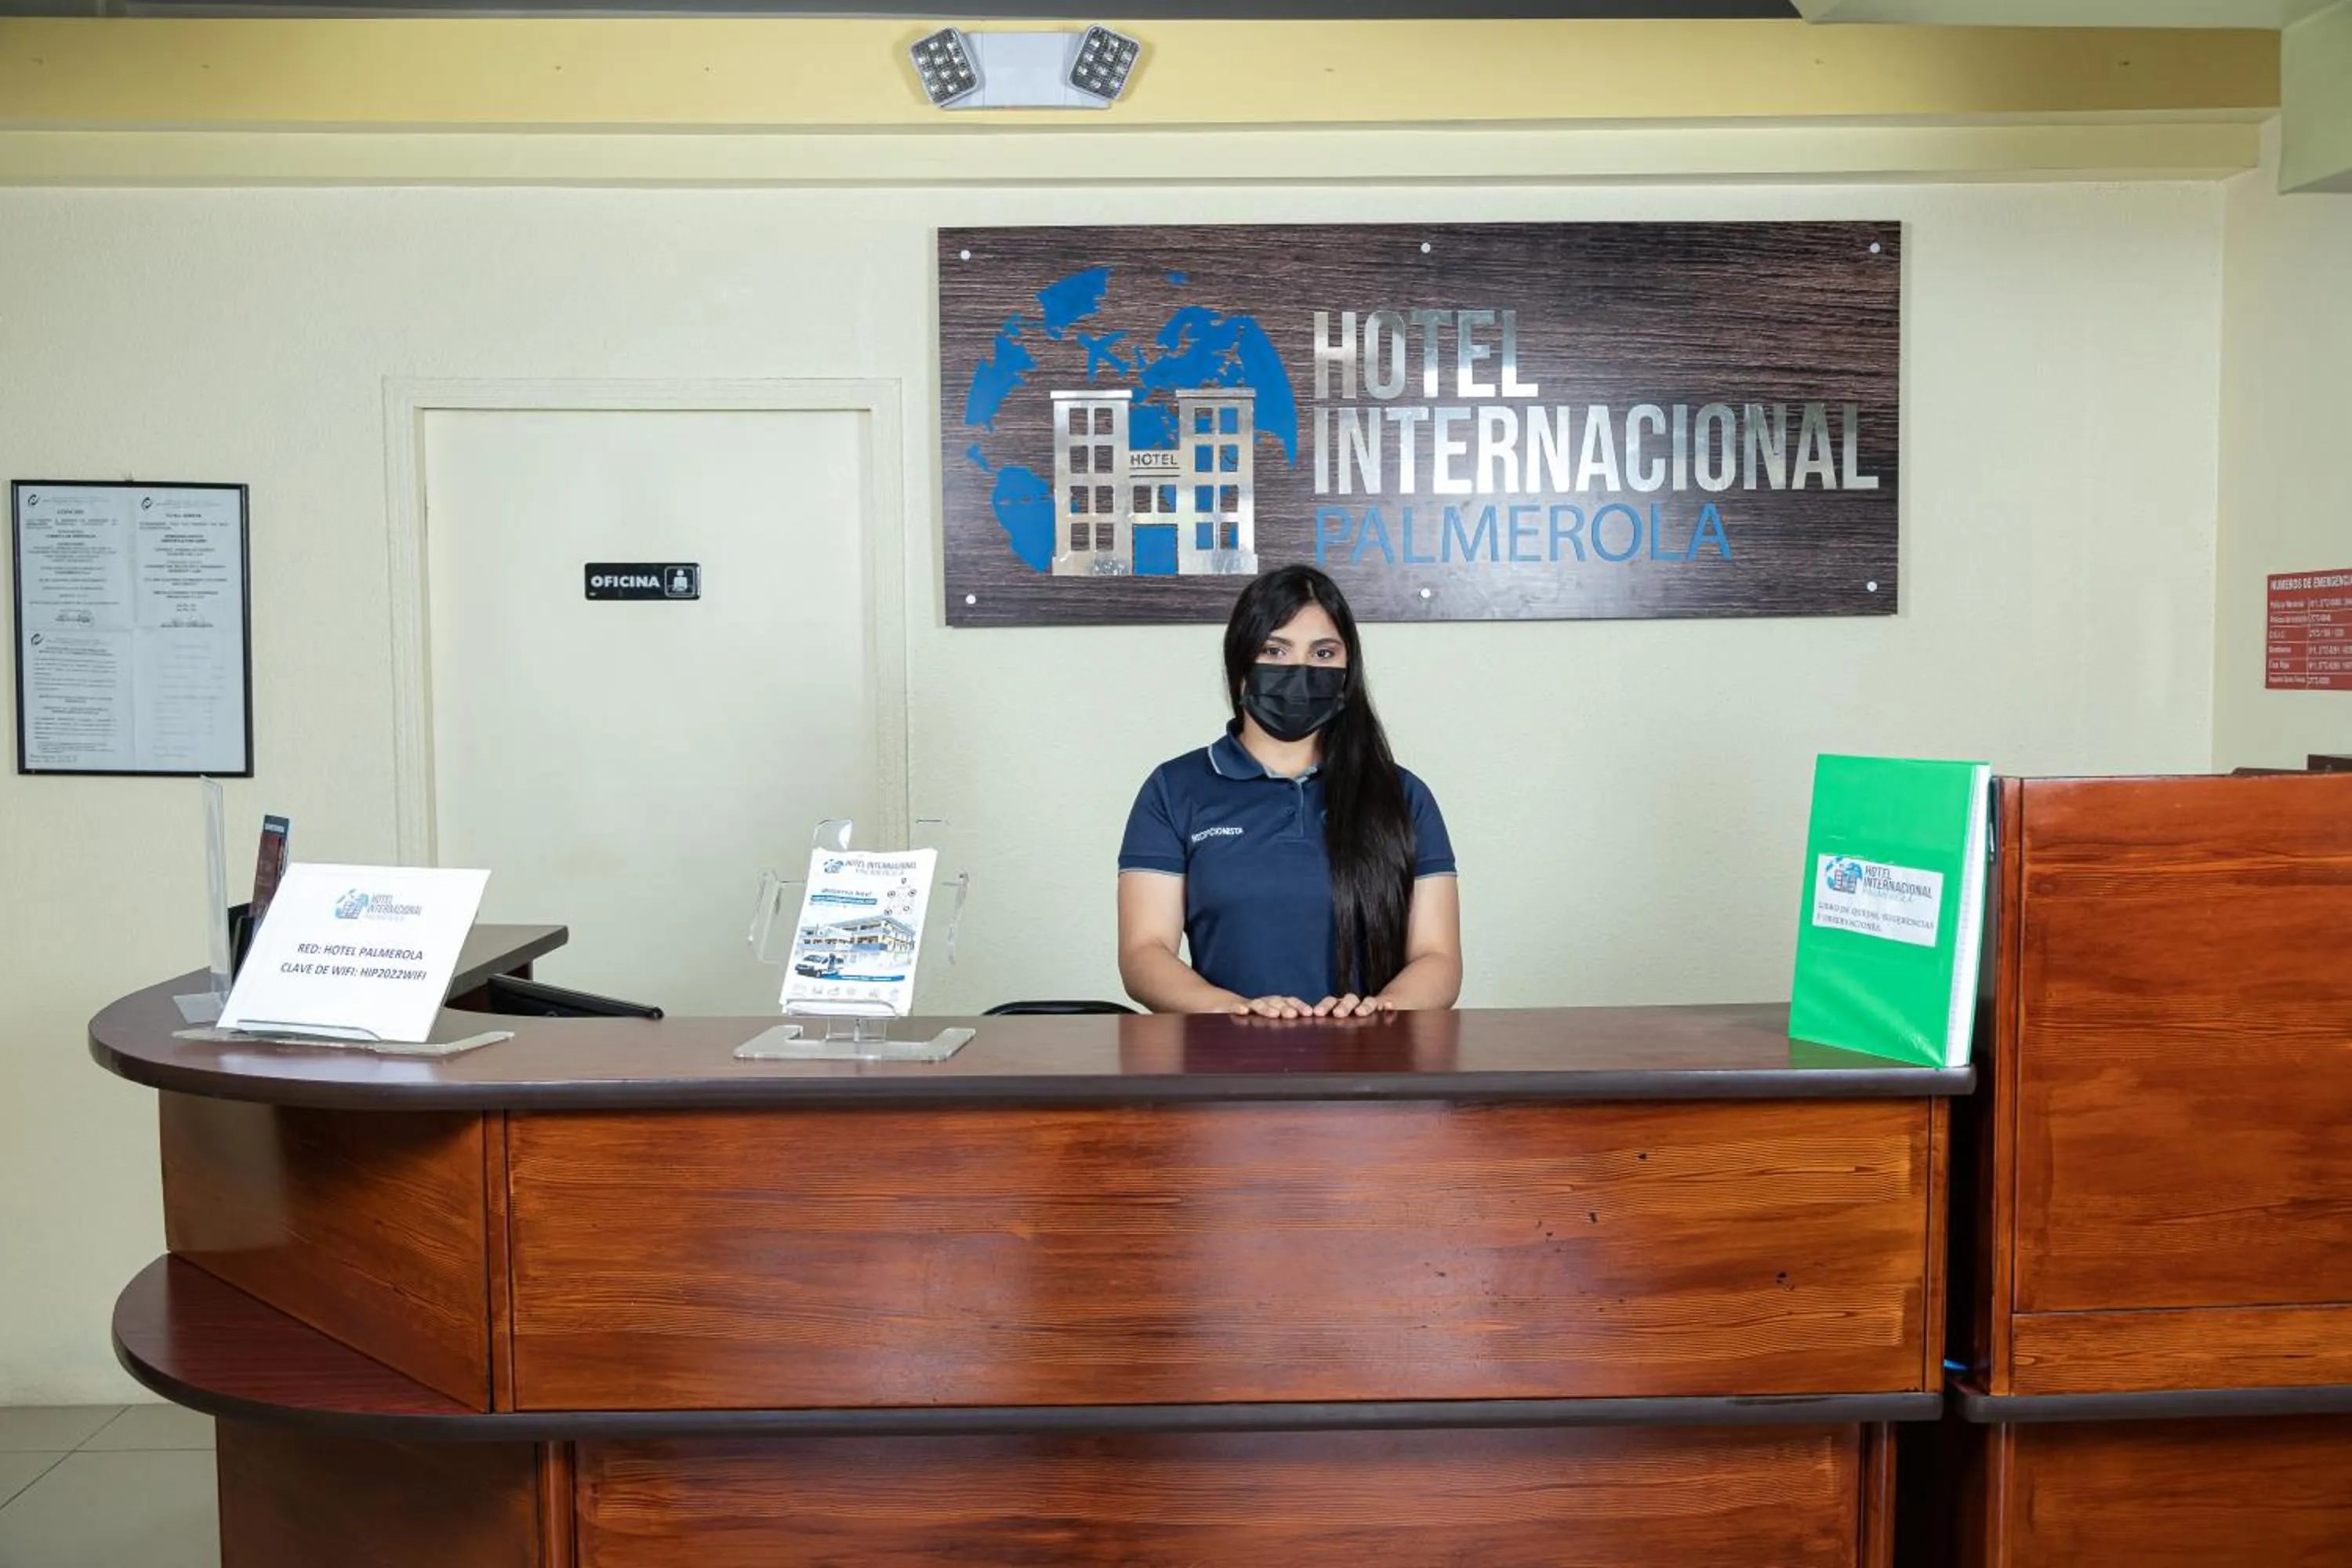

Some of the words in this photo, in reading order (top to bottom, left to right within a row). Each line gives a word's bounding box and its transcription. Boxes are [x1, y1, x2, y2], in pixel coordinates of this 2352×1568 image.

[1314, 310, 1539, 400] HOTEL
[1314, 404, 1880, 495] INTERNACIONAL
[1131, 452, 1178, 469] HOTEL
[1317, 503, 1733, 568] PALMEROLA
[590, 575, 661, 588] OFICINA
[1865, 865, 1891, 880] HOTEL
[1864, 878, 1933, 898] INTERNACIONAL
[297, 943, 321, 954] RED:
[323, 945, 356, 956] HOTEL
[358, 946, 423, 960] PALMEROLA
[280, 962, 312, 974] CLAVE
[314, 964, 329, 975] DE
[332, 966, 358, 977] WIFI:
